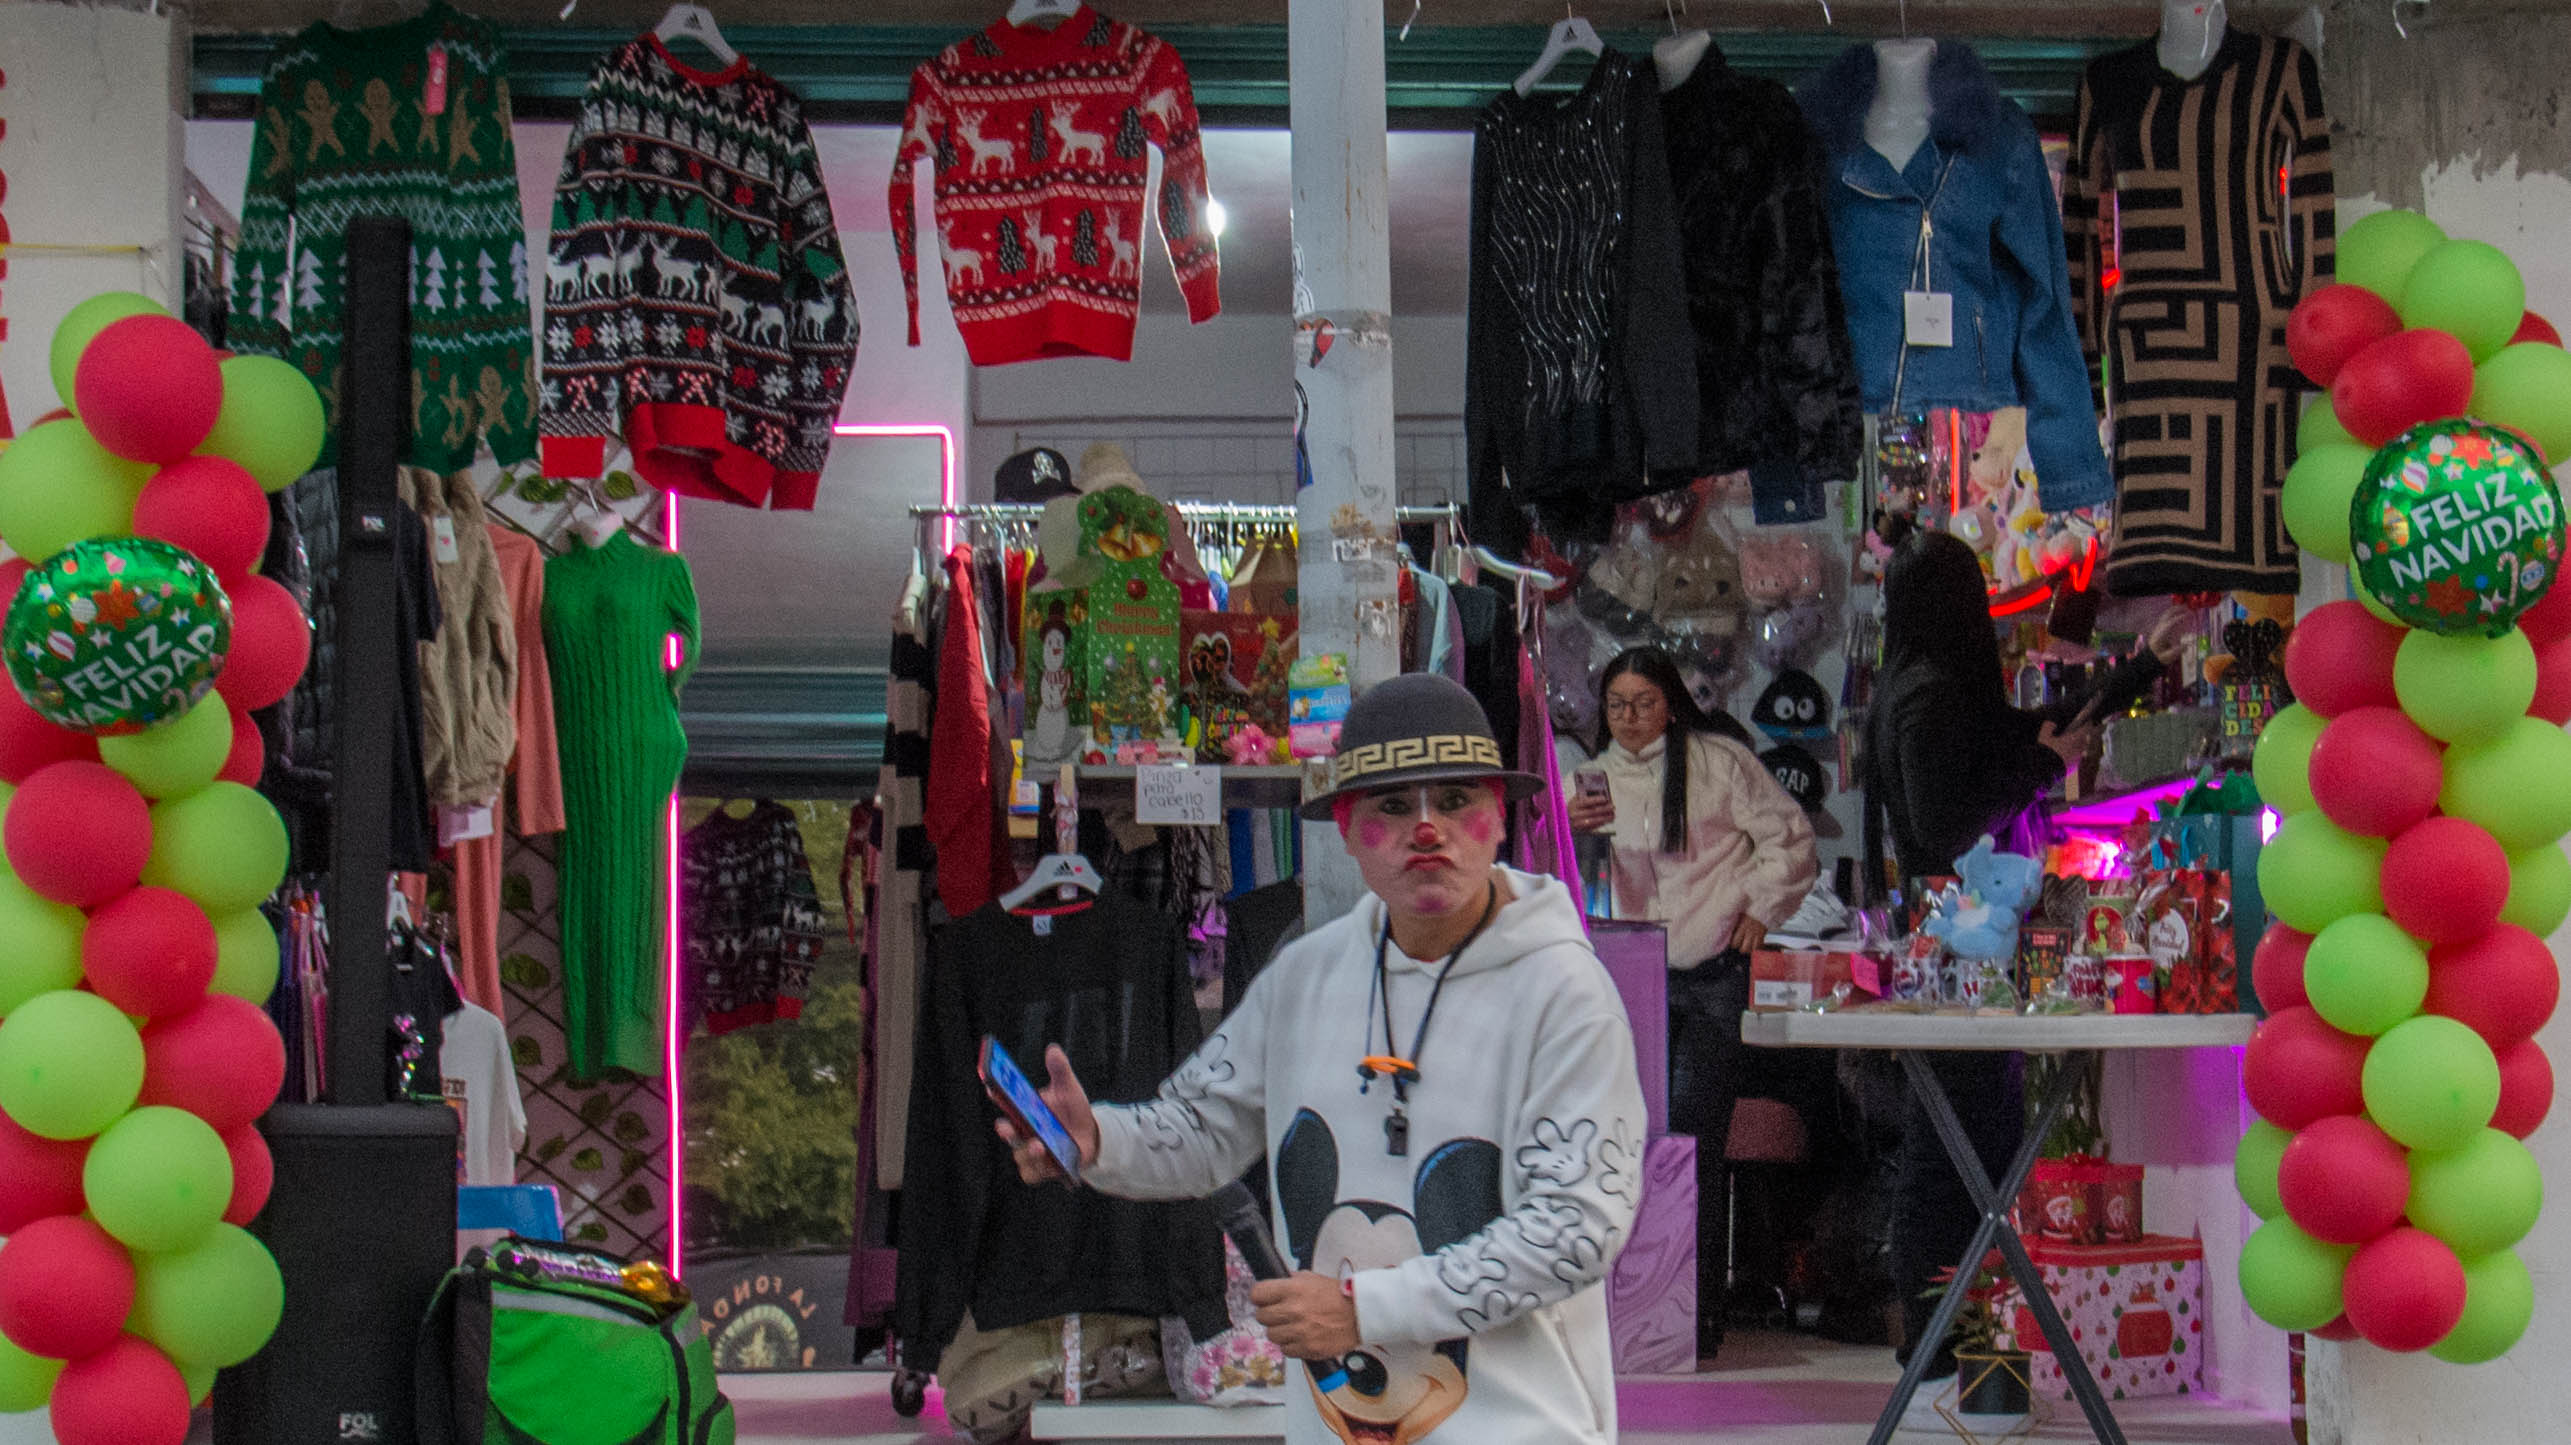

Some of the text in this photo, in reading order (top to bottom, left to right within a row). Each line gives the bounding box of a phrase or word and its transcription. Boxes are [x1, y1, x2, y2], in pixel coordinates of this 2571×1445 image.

[2388, 495, 2556, 588] NAVIDAD
[2410, 471, 2517, 539] FELIZ
[51, 624, 216, 726] NAVIDAD
[62, 624, 172, 699] FELIZ
